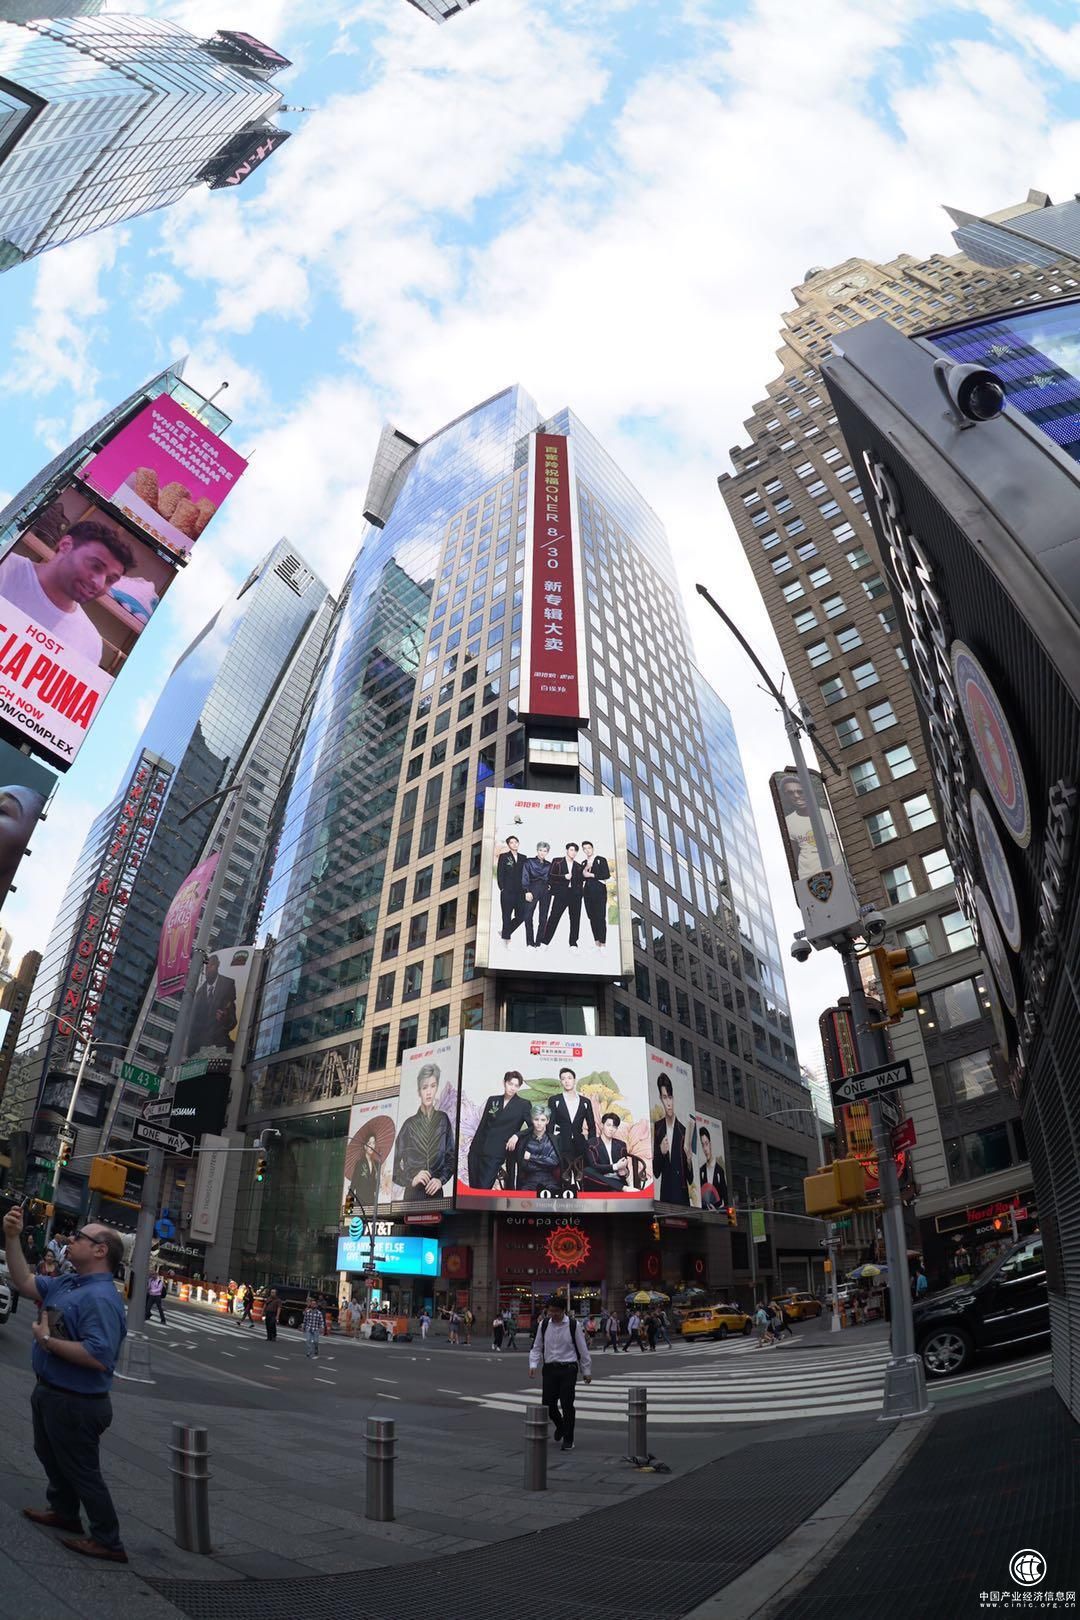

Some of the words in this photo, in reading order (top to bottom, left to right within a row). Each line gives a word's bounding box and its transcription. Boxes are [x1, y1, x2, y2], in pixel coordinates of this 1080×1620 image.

[152, 409, 187, 442] WHILE
[189, 440, 234, 481] THEY'RE
[176, 420, 199, 439] GET
[200, 438, 219, 459] 'EM
[544, 581, 564, 652] 新专辑大卖
[25, 624, 65, 655] HOST
[21, 653, 100, 730] PUMA
[16, 697, 45, 720] NOW
[110, 767, 148, 858] ERNST
[57, 915, 99, 1037] YOUNG
[124, 1064, 134, 1080] W
[137, 1073, 150, 1086] 43
[844, 1081, 866, 1096] ONE
[876, 1070, 901, 1086] WAY
[142, 1128, 161, 1141] ONE
[167, 1135, 185, 1149] WAY
[506, 1216, 552, 1227] europa
[967, 1205, 993, 1221] Hard
[995, 1199, 1020, 1214] Rok
[165, 1242, 199, 1257] CHASE
[385, 1242, 405, 1253] ELSE
